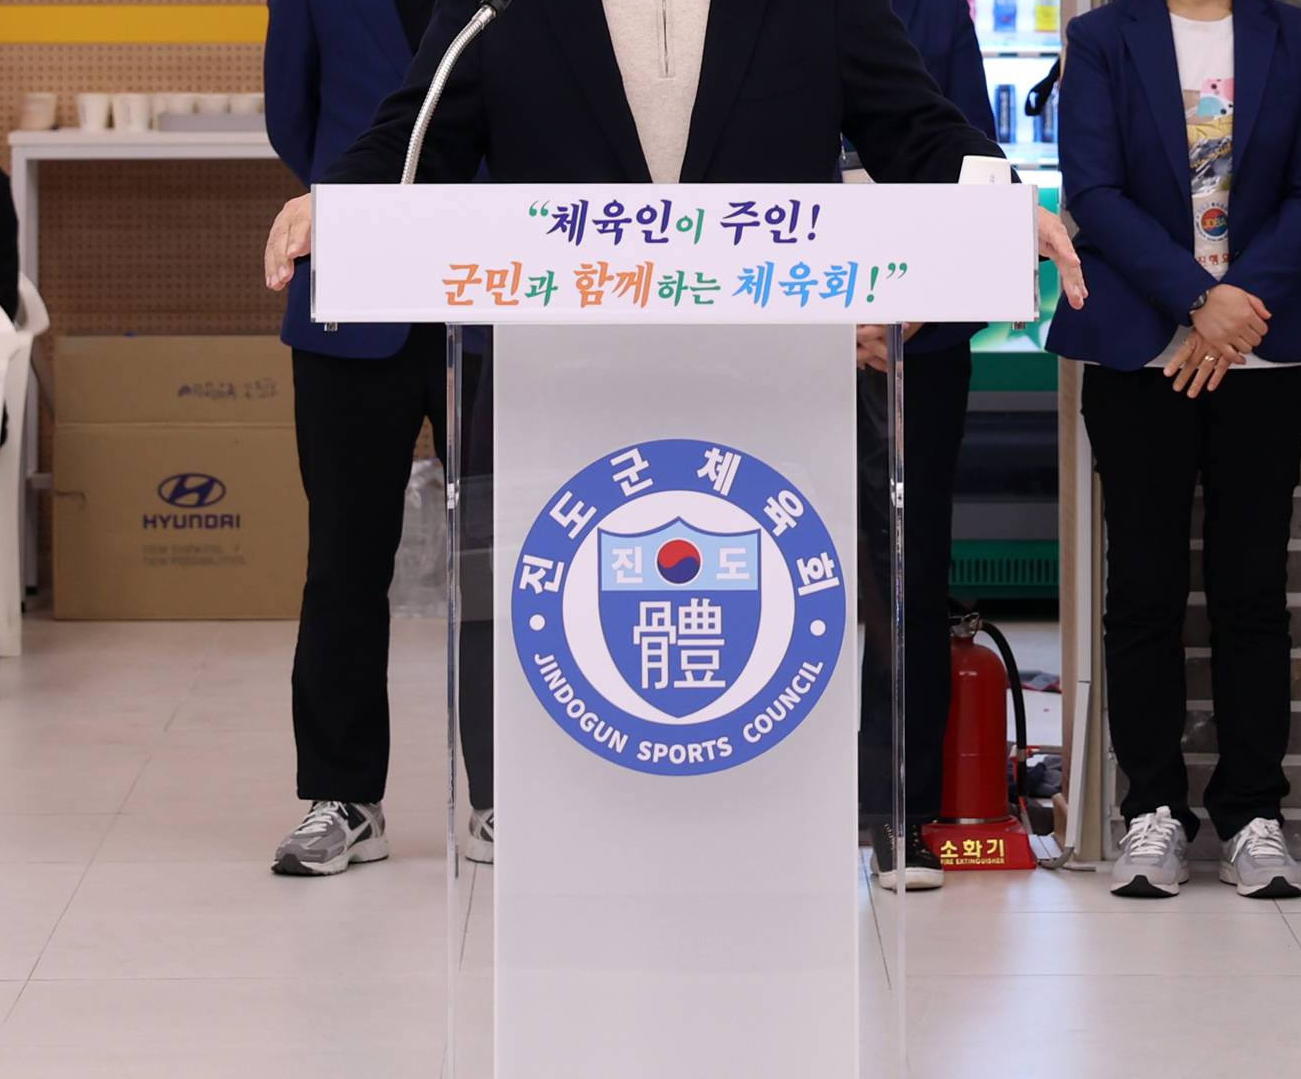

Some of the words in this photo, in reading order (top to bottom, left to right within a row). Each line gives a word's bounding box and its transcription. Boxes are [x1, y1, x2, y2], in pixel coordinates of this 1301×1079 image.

[720, 199, 820, 245] 주인!
[441, 261, 559, 307] 군민과
[573, 261, 721, 307] 함께하는
[143, 514, 241, 530] HYUNDAI
[533, 652, 629, 753] JINDOGUN
[636, 736, 733, 765] SPORTS
[742, 660, 824, 743] COUNCIL
[940, 839, 1005, 858] 소화기
